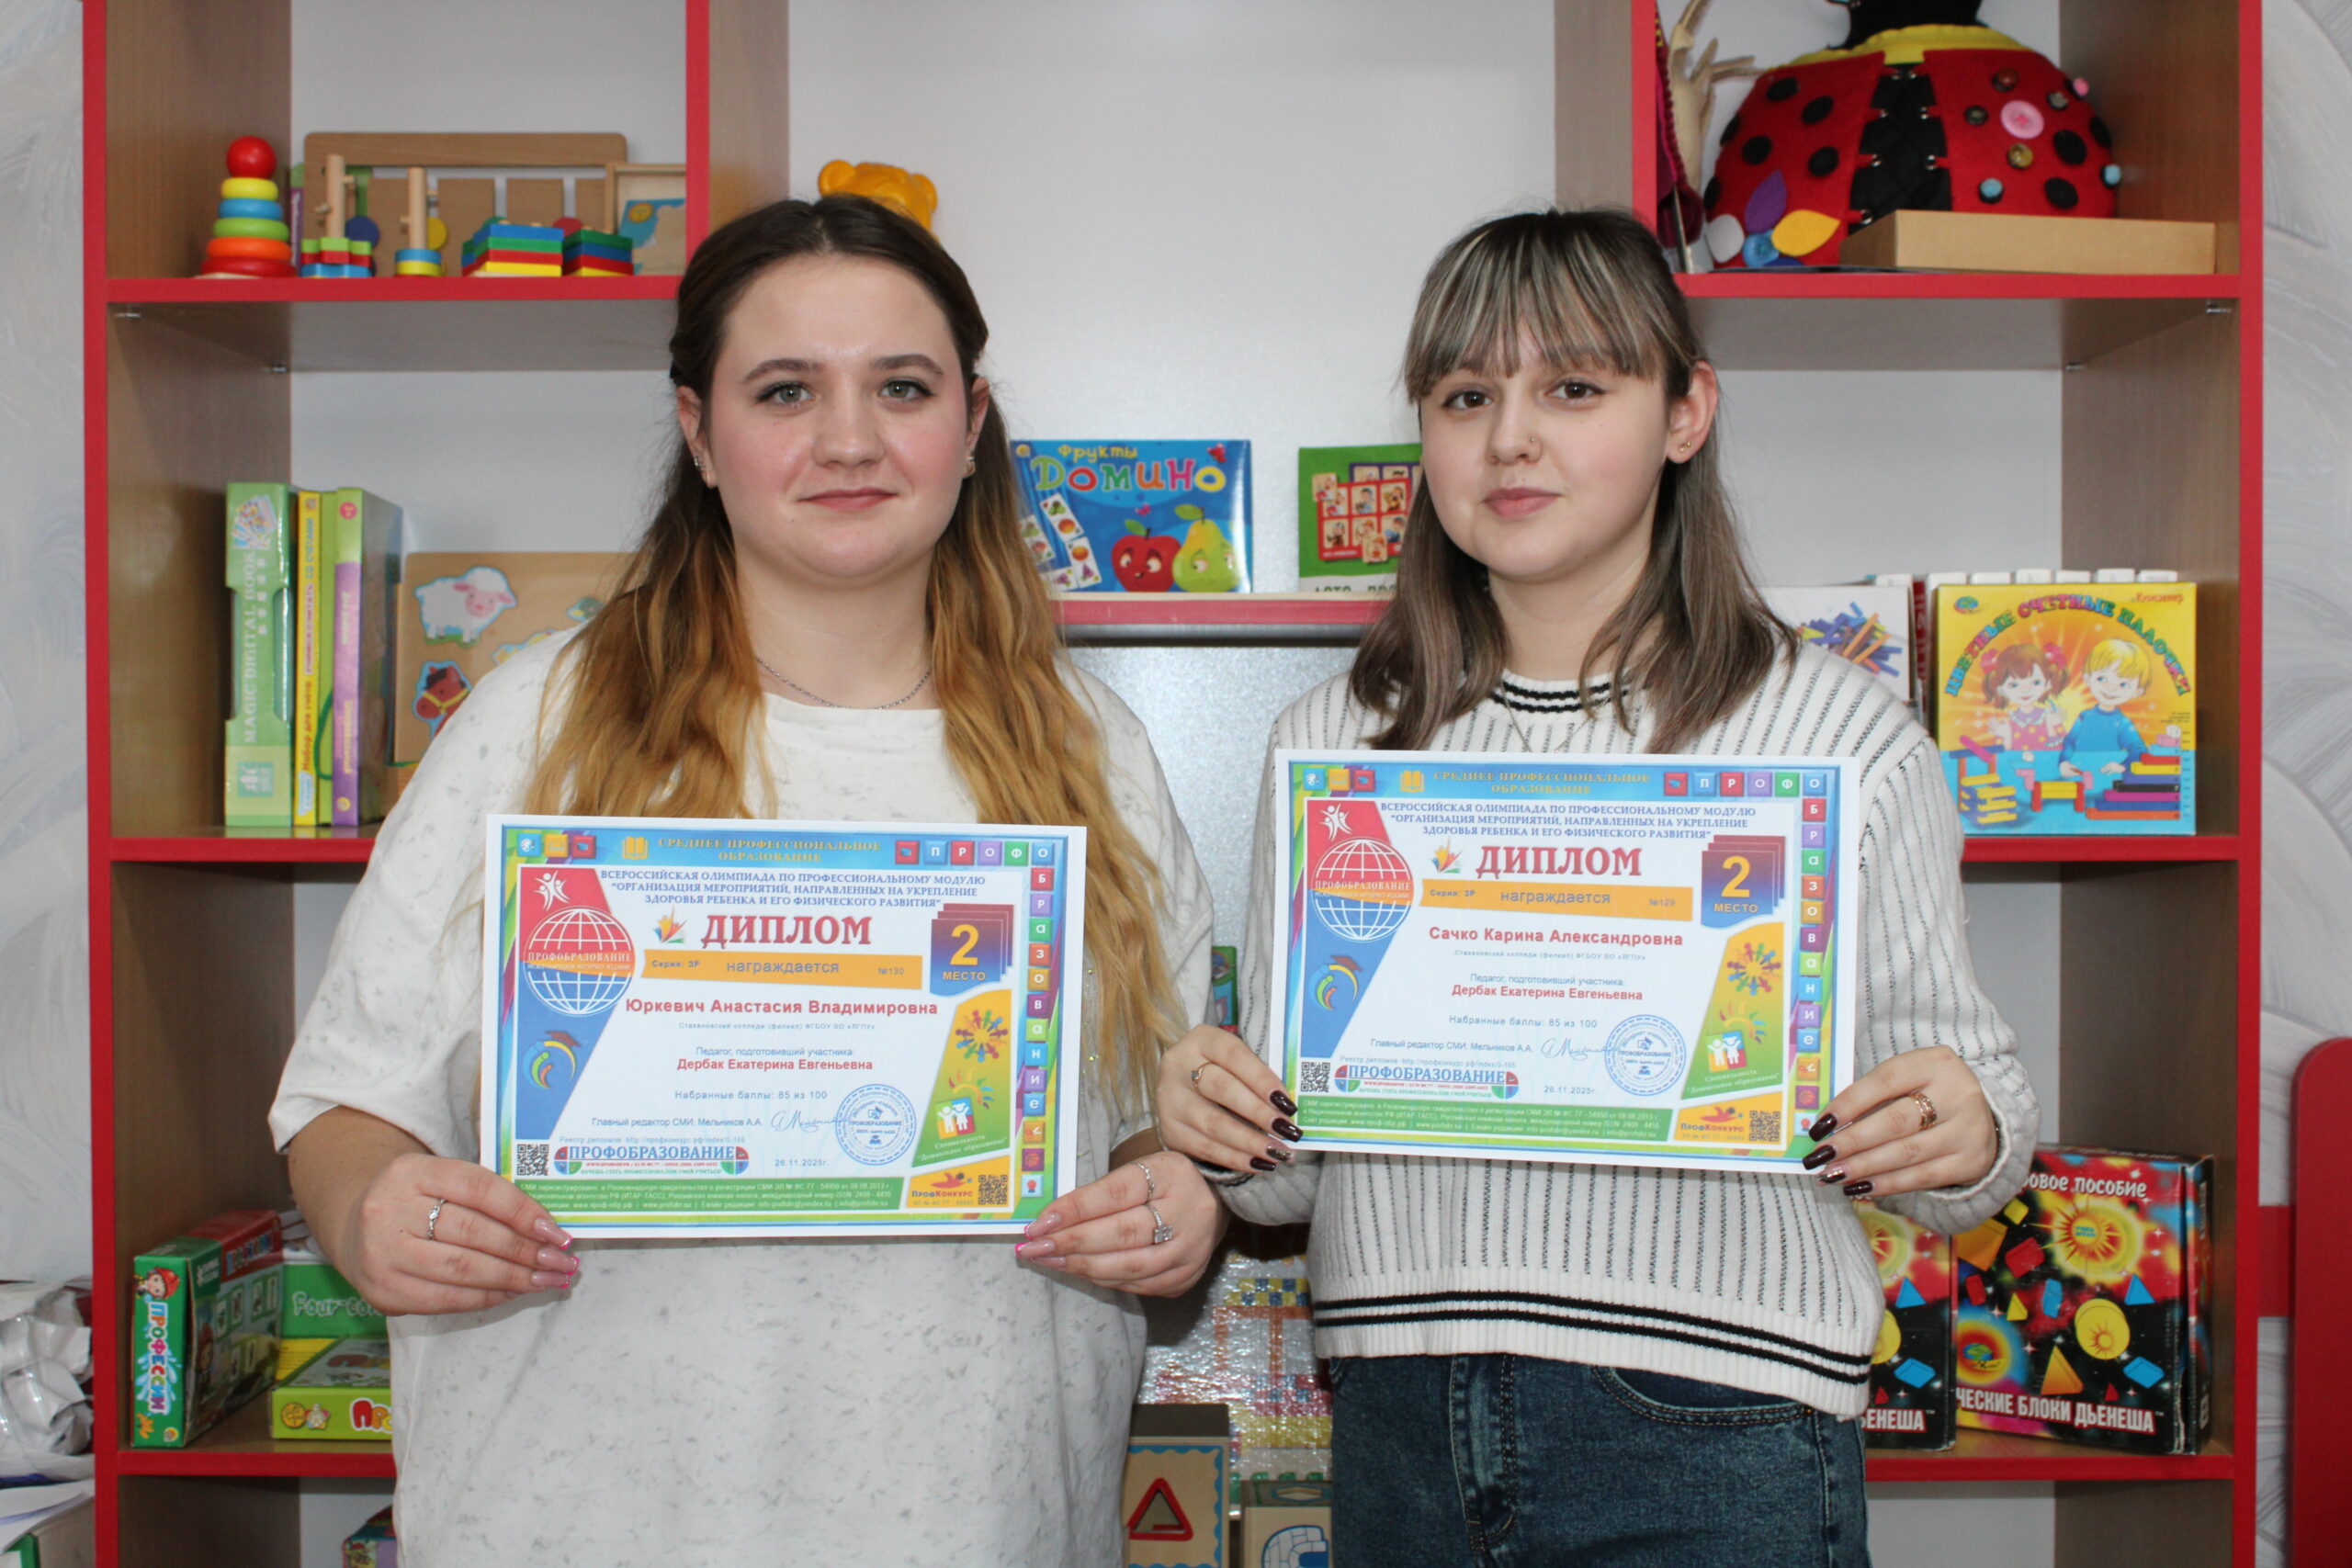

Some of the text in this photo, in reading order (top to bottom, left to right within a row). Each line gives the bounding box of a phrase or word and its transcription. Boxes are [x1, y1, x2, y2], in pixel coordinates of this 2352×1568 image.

[1057, 444, 1138, 463] Фрукты
[243, 551, 257, 744] MAGIC DIGITAL BOOK
[1944, 610, 2017, 697] ЦВЕТНЫЕ
[2018, 593, 2115, 618] СЧЕТНЫЕ
[1381, 801, 1756, 817] ВСЕРОССИЙСКАЯ ОЛИМПИАДА ПО ПРОФЕССИОНАЛЬНОМУ МОДУЛЮ
[1476, 814, 1560, 825] МЕРОПРИЯТИЙ,
[1564, 817, 1653, 828] НАПРАВЛЕННЫХ
[1676, 818, 1747, 829] УКРЕПЛЕНИЕ
[1423, 826, 1477, 835] ЗДОРОВЬЯ
[1481, 827, 1528, 835] РЕБЕНКА
[1542, 828, 1561, 836] ЕГО
[1564, 829, 1645, 837] ФИЗИЧЕСКОГО
[1474, 845, 1642, 883] ДИПЛОМ
[601, 869, 985, 885] ВСЕРОССИЙСКАЯ ОЛИМПИАДА ПО ПРОФЕССИОНАЛЬНОМУ МОДУЛЮ
[1722, 856, 1750, 899] 2
[702, 882, 790, 893] МЕРОПРИЯТИЙ,
[794, 886, 884, 896] НАПРАВЛЕННЫХ
[886, 886, 902, 895] НА
[907, 886, 977, 897] УКРЕПЛЕНИЕ
[1500, 886, 1611, 907] награждается
[646, 895, 703, 904] ЗДОРОВЬЯ
[707, 896, 755, 904] РЕБЕНКА
[793, 897, 876, 906] ФИЗИЧЕСКОГО
[1713, 903, 1758, 913] МЕСТО
[700, 914, 872, 952] ДИПЛОМ
[1429, 926, 1682, 947] Сачко Карина Александровна
[950, 924, 978, 964] 2
[726, 956, 840, 976] награждается
[943, 971, 986, 981] МЕСТО
[1470, 973, 1624, 987] Педагог, подготовивший участника:
[1452, 984, 1642, 999] Дербак Екатерина Евгеньевна
[626, 998, 937, 1016] Юркевич Анастасия Владимировна
[1449, 1015, 1505, 1025] Набранные
[1510, 1017, 1544, 1026] баллы:
[1579, 1020, 1597, 1028] 100
[695, 1046, 732, 1055] Педагог,
[736, 1047, 805, 1055] подготовивший
[1371, 1038, 1532, 1052] Главный редактор СМИ: Мельников А.А.
[676, 1058, 873, 1071] Дербак Екатерина Евгеньевна
[1348, 1065, 1506, 1083] ПРОФОБРАЗОВАНИЕ
[674, 1090, 733, 1100] Набранные
[738, 1090, 773, 1099] баллы:
[778, 1090, 790, 1099] 85
[810, 1090, 827, 1099] 100
[592, 1117, 628, 1125] Главный
[631, 1119, 670, 1127] редактор
[568, 1145, 736, 1159] ПРОФОБРАЗОВАНИЕ
[148, 1302, 168, 1414] ПРОФЕССИИ
[2018, 1395, 2072, 1422] БЛОКИ
[2074, 1402, 2154, 1433] ДЬЕНЕША
